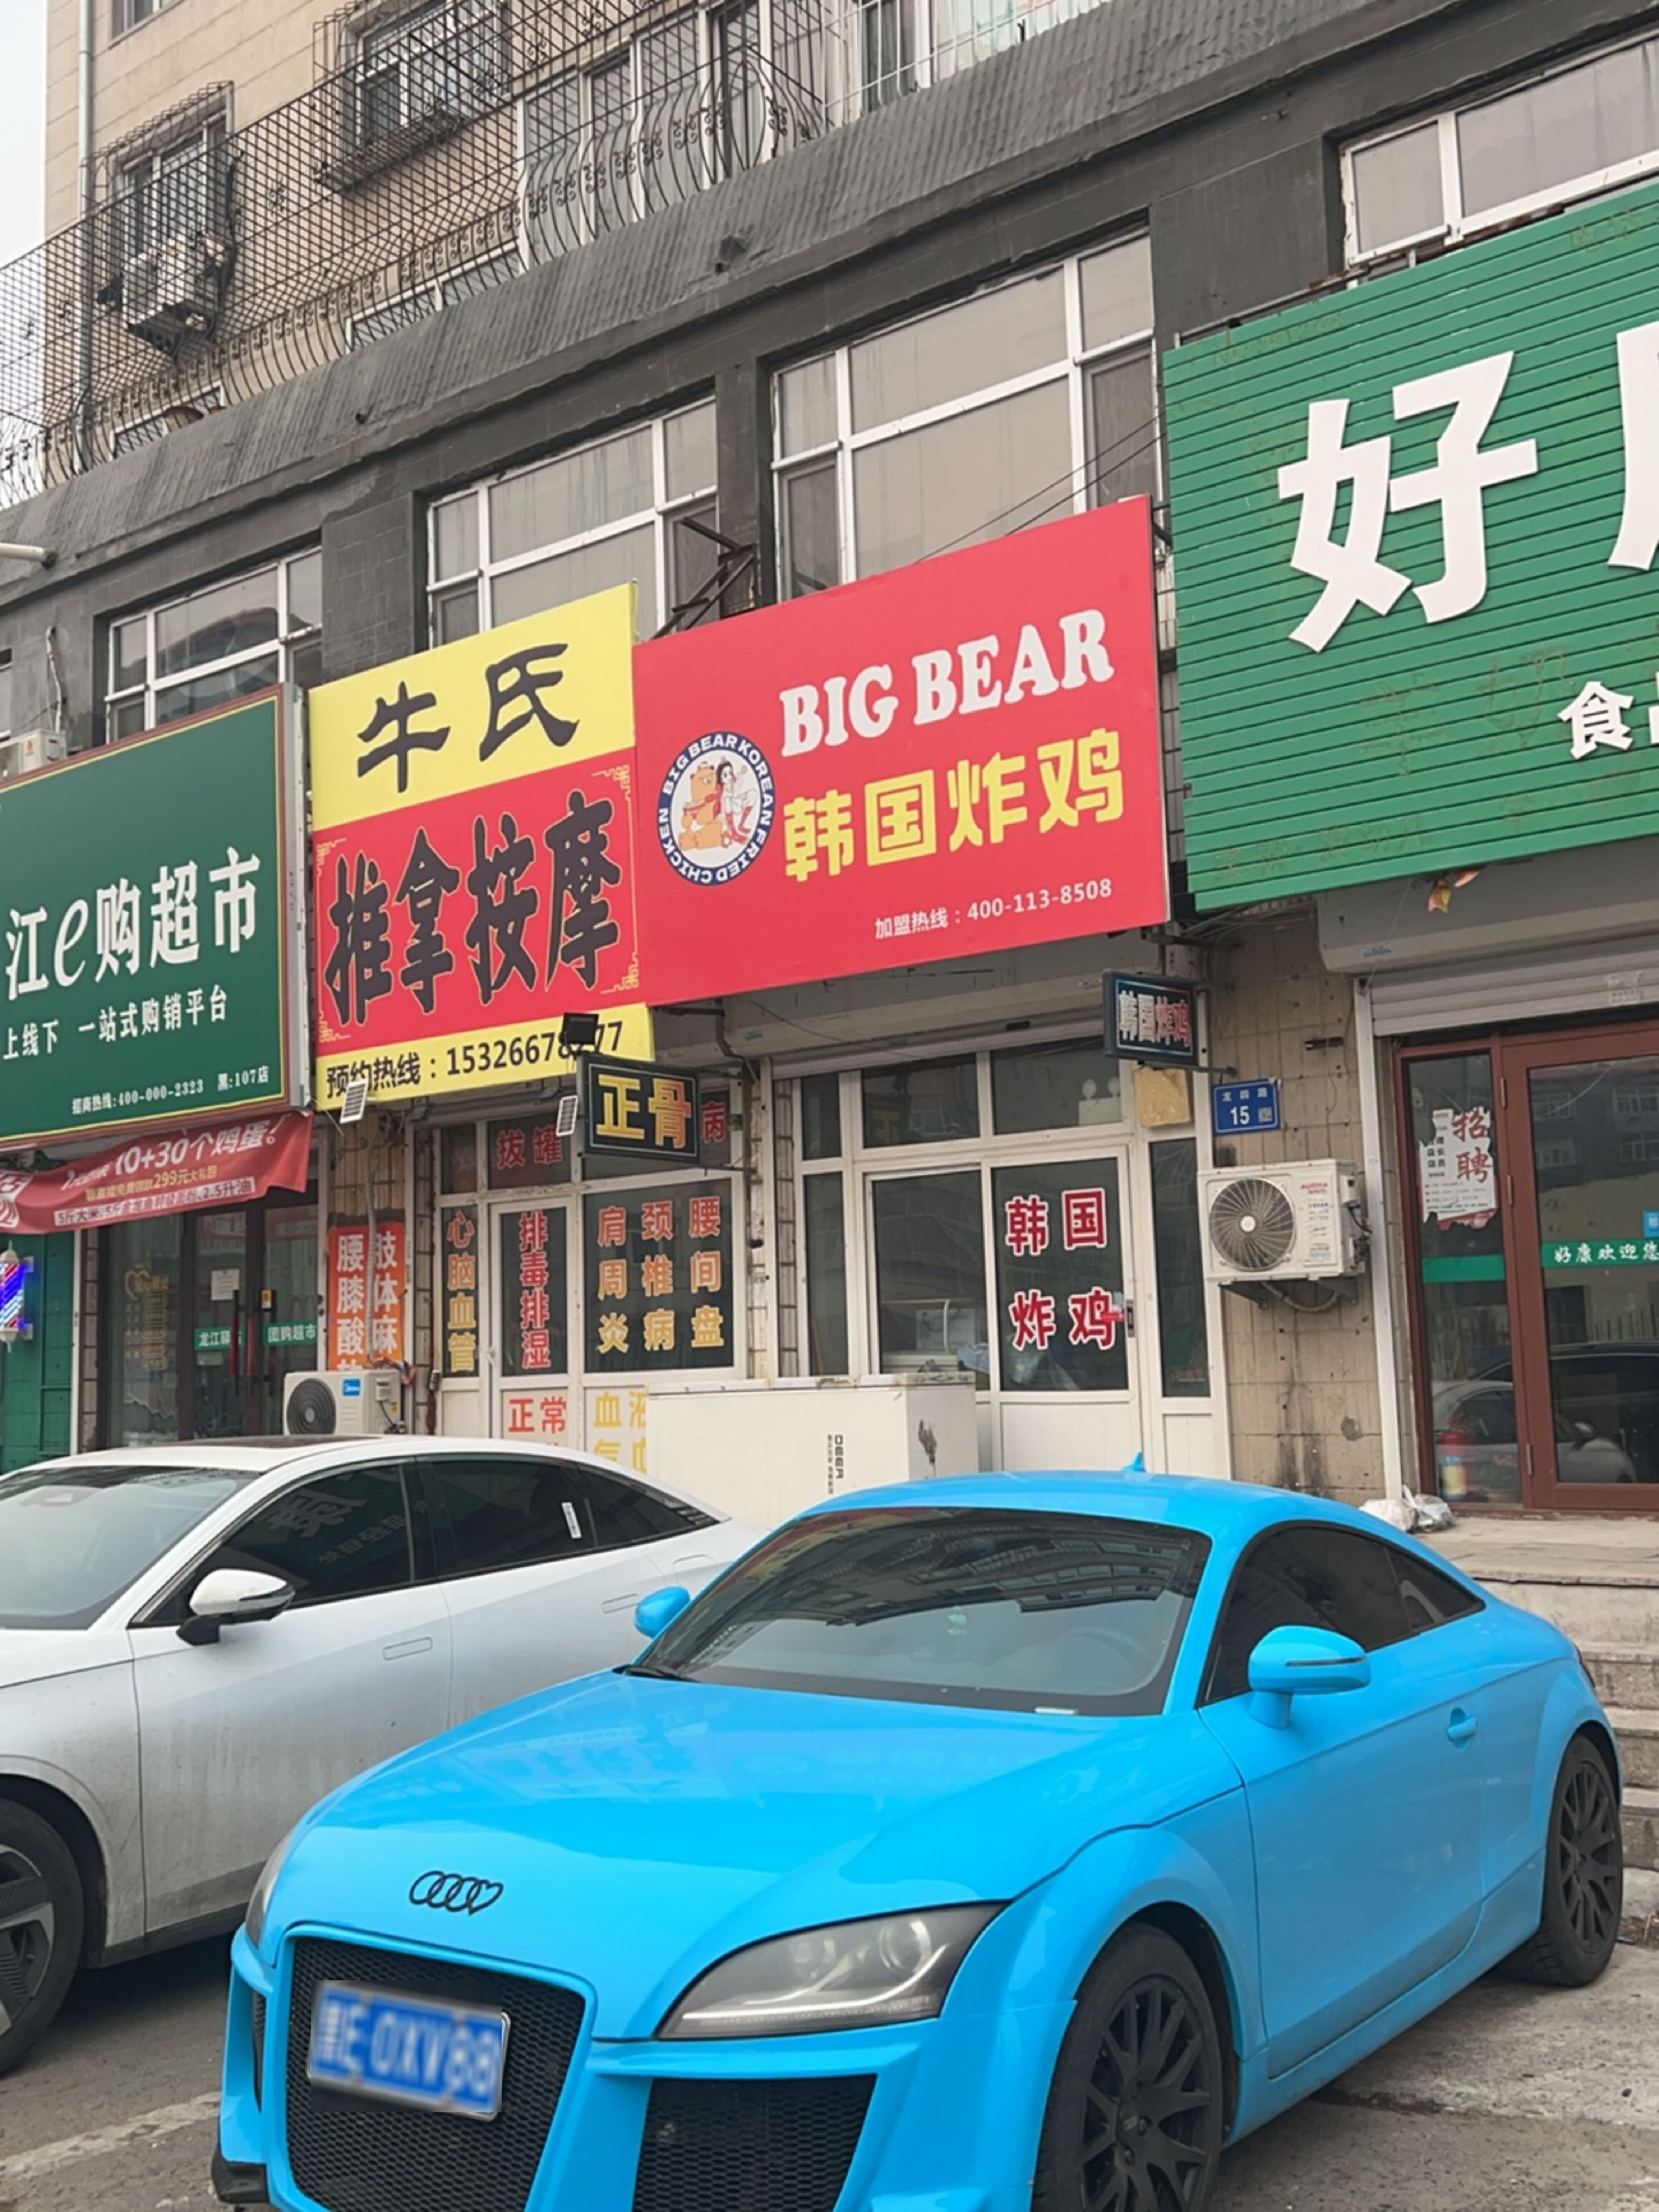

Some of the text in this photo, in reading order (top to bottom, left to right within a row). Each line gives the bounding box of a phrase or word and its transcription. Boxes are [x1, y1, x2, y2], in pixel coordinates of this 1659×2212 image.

[1277, 320, 1659, 653] 好
[356, 643, 581, 794] 牛氏
[779, 609, 1114, 758] BIG BEAR
[1557, 671, 1659, 760] 食
[658, 733, 774, 884] BIG BEAR KOREAN FRIED CHICKEN
[783, 728, 1125, 883] 韩国炸鸡
[323, 789, 622, 1027] 推拿按摩
[3, 984, 227, 1060] 上线下 一站式购销平台
[326, 1020, 623, 1099] 预约热线：1532667877
[1119, 990, 1190, 1048] 韩国炸鸡
[497, 1123, 563, 1170] 拔罐
[597, 1073, 692, 1150] 正骨
[1230, 1105, 1249, 1125] 15
[1451, 1109, 1493, 1183] 招聘
[1006, 1188, 1107, 1256] 韩国
[1554, 1240, 1659, 1263] 好康欢迎您
[337, 1233, 365, 1372] 腰膝酸
[447, 1210, 478, 1374] 心脑血管
[519, 1210, 552, 1370] 排毒排湿
[597, 1206, 629, 1355] 肩周炎
[641, 1200, 675, 1351] 颈椎病
[688, 1196, 725, 1348] 腰间盘
[268, 1323, 317, 1343] 团购超市
[1009, 1286, 1118, 1351] 炸鸡
[508, 1395, 568, 1434] 正常
